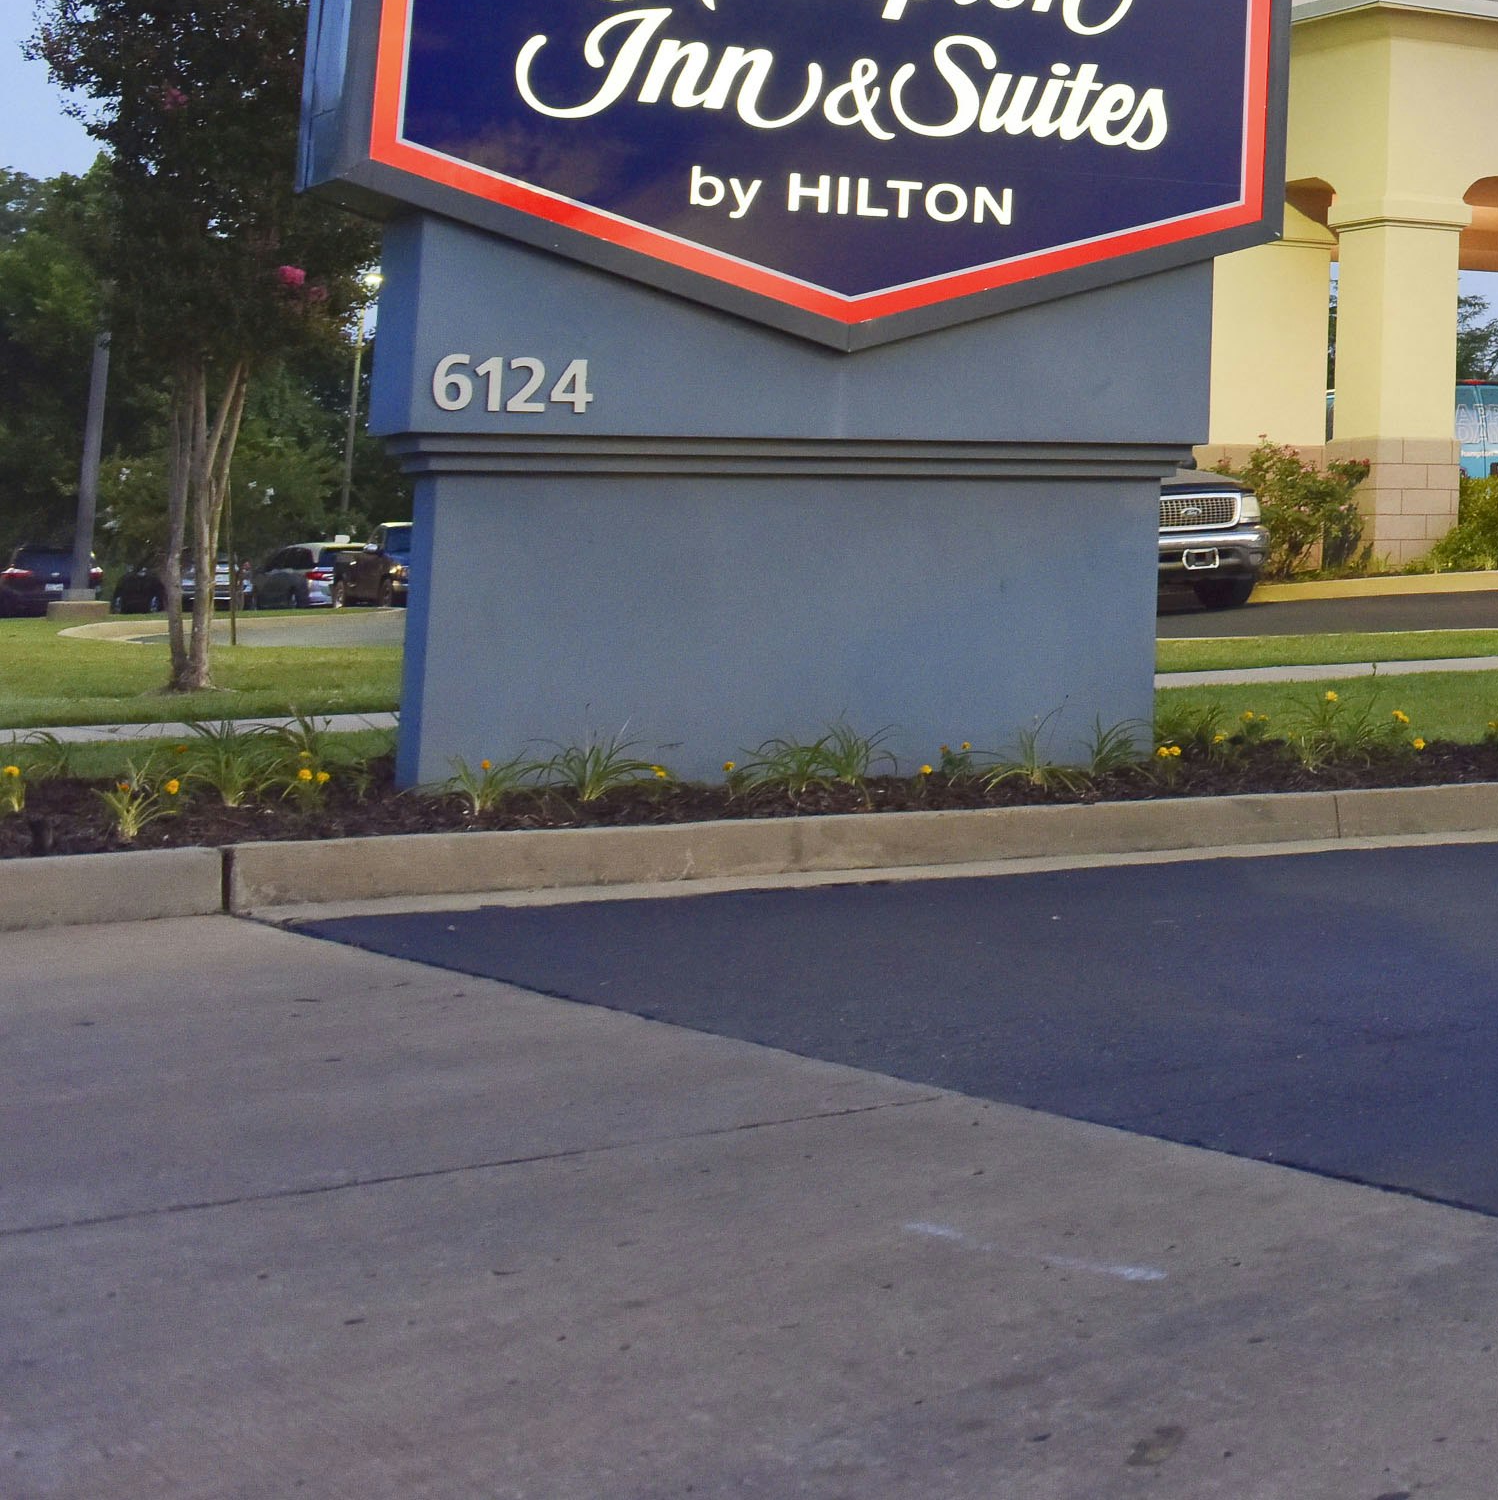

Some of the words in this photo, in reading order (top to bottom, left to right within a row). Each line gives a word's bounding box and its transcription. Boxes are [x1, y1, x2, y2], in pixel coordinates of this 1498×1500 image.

[515, 7, 823, 130] Inn
[823, 58, 897, 141] &
[890, 35, 1169, 151] Suites
[689, 165, 763, 219] by
[787, 172, 1014, 226] HILTON
[432, 353, 594, 413] 6124
